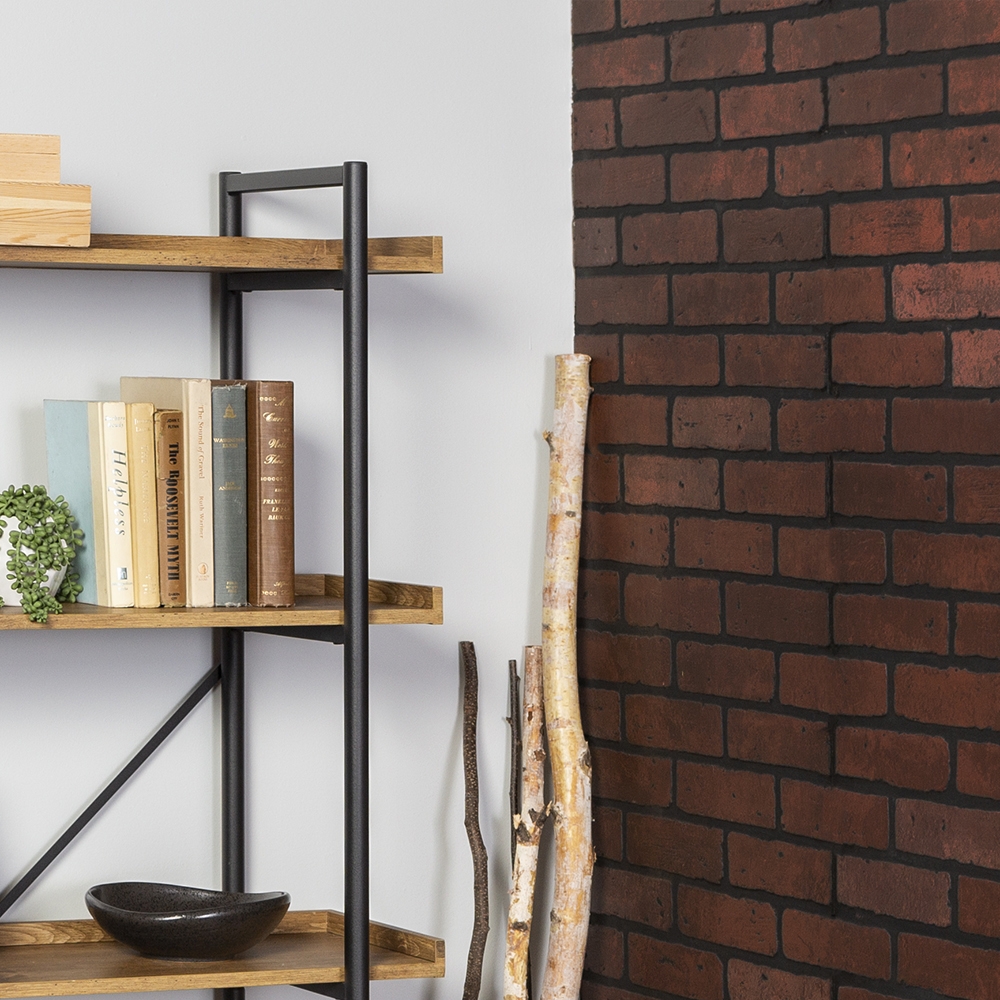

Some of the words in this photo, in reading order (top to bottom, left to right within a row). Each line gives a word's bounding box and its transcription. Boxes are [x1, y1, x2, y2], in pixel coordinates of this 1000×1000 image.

[169, 442, 179, 465] The
[108, 450, 129, 536] Helpless
[166, 470, 179, 540] ROOSEVELT
[167, 545, 180, 580] MYTH
